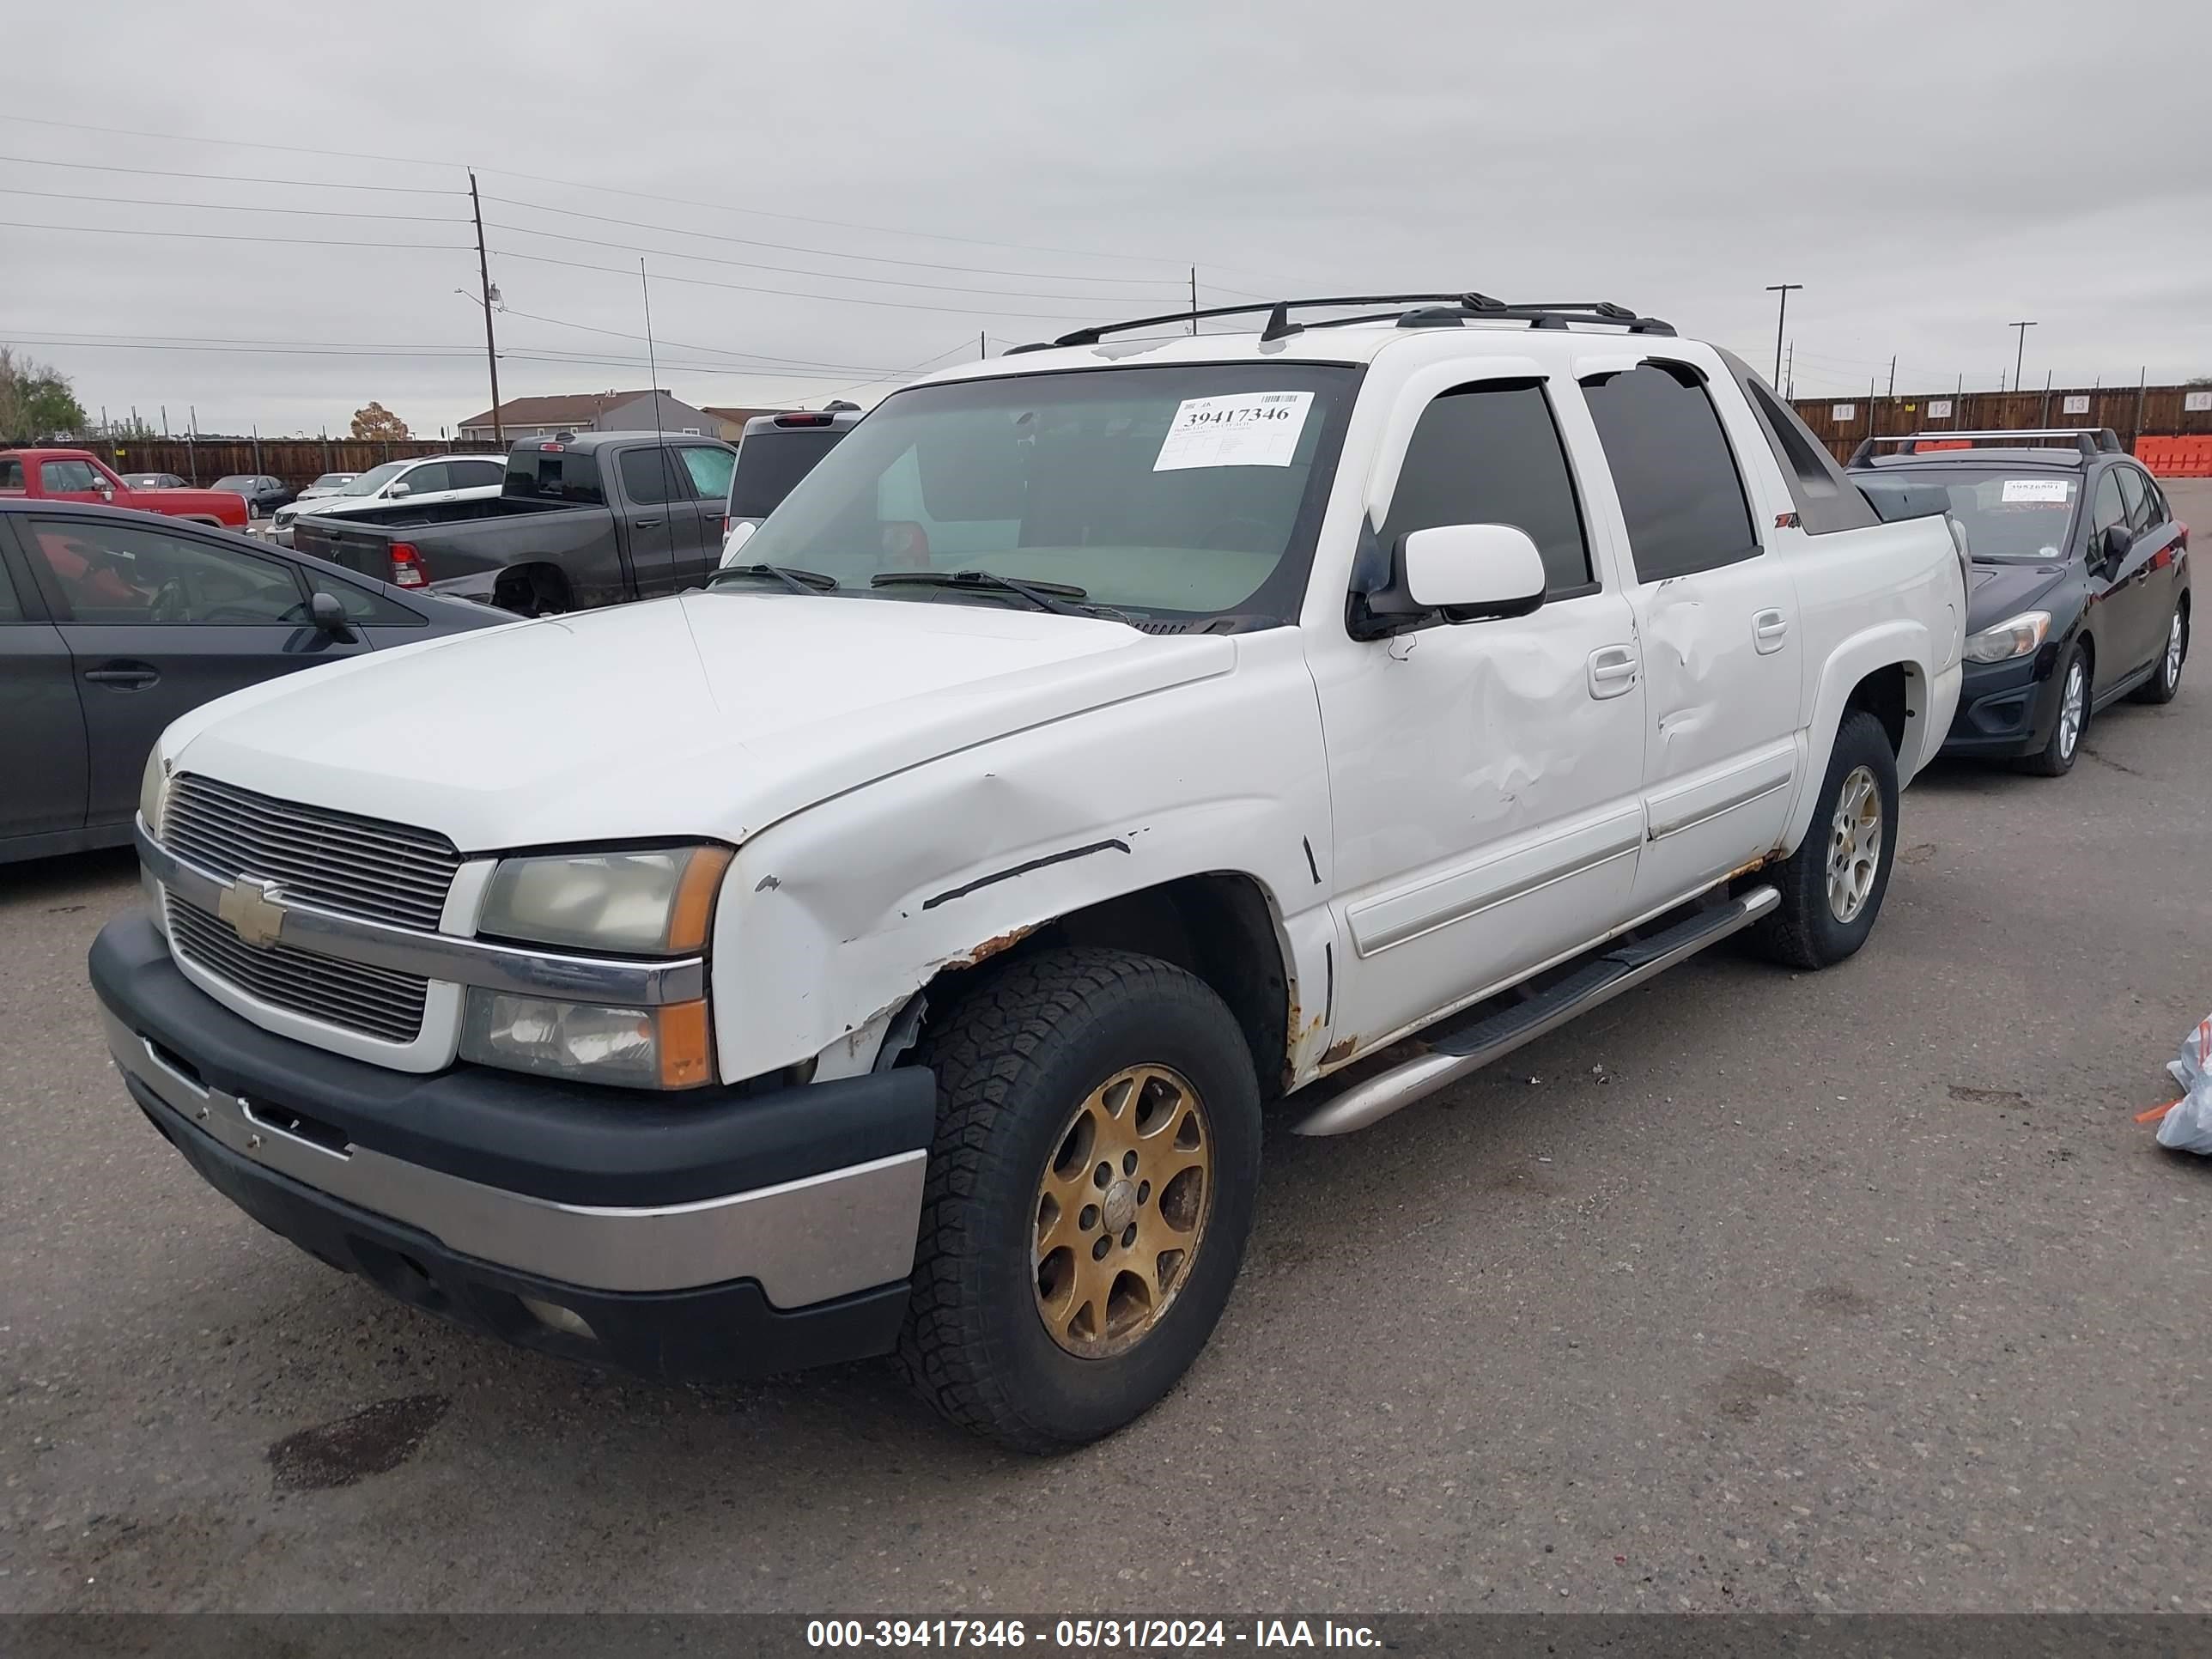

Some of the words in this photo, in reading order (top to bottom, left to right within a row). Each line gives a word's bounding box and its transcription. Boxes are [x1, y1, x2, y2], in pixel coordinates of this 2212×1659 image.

[2069, 398, 2085, 410] 13
[2194, 396, 2209, 408] 14
[1837, 406, 1850, 419] 11
[1932, 403, 1948, 416] 12
[1184, 407, 1291, 428] 39417346
